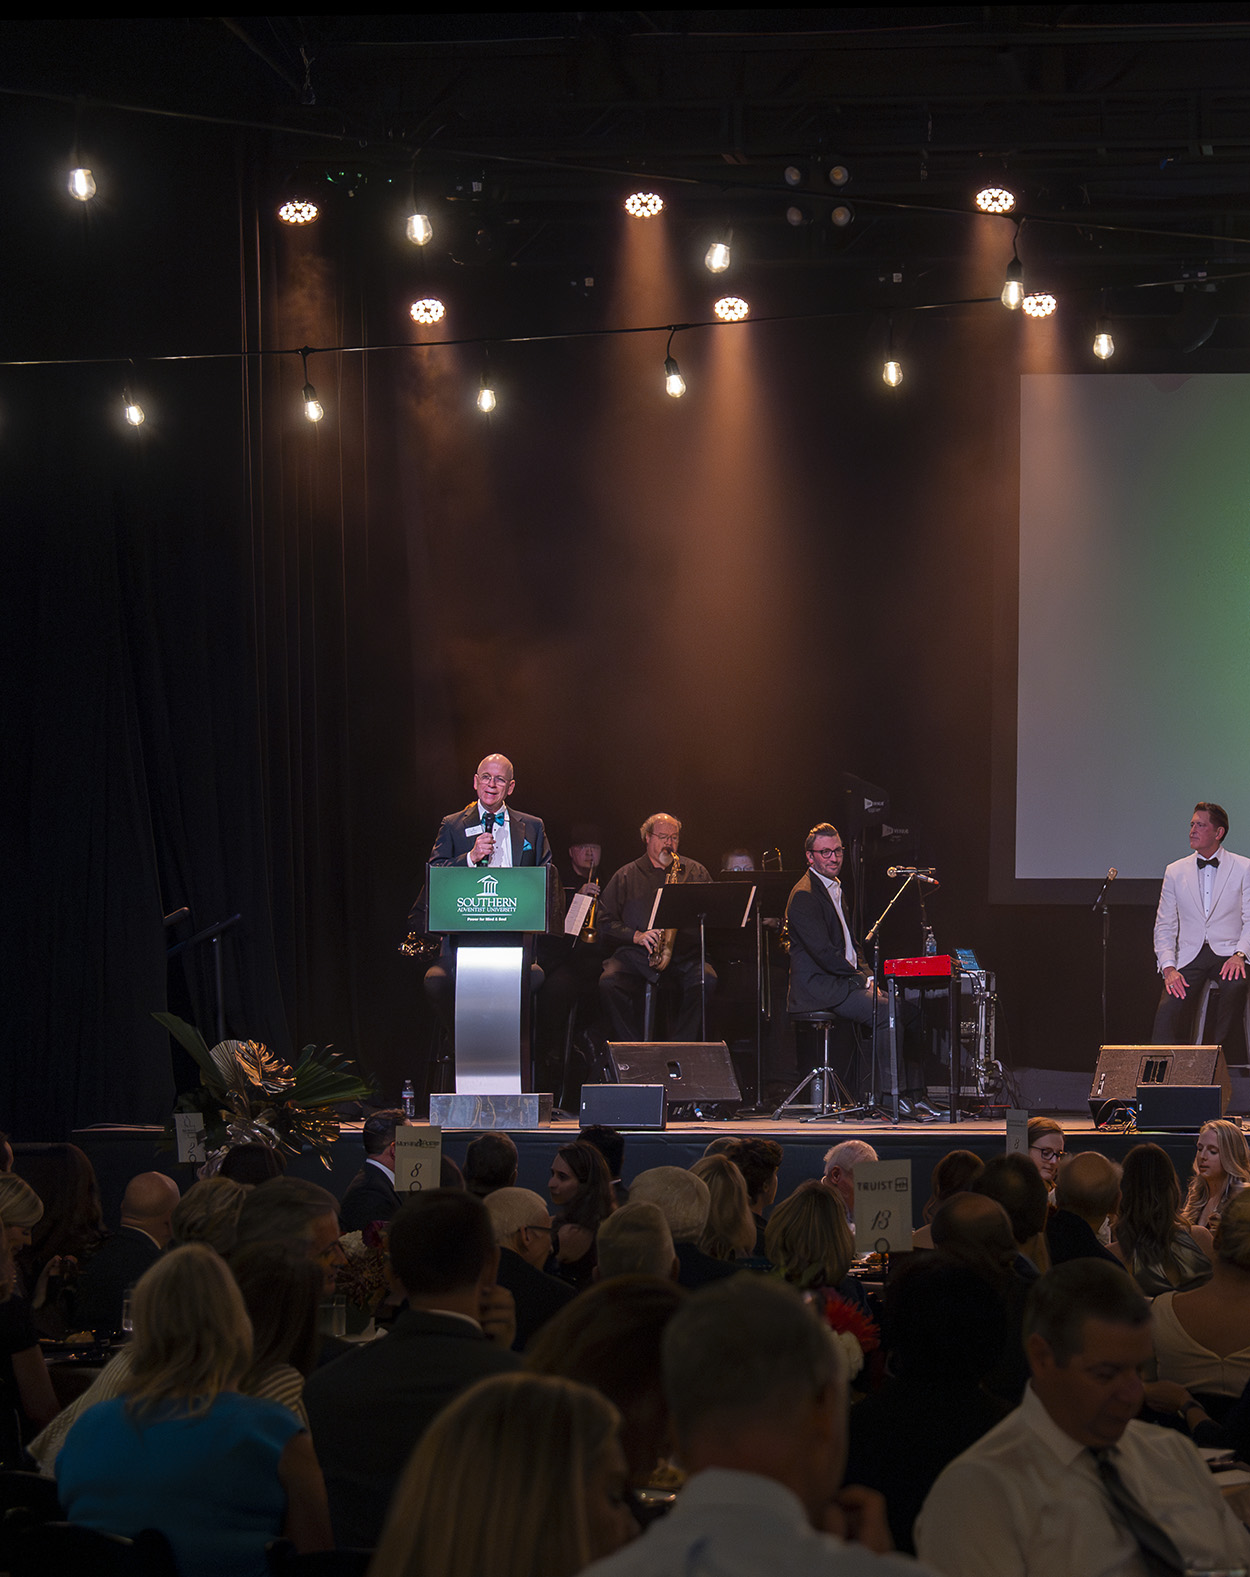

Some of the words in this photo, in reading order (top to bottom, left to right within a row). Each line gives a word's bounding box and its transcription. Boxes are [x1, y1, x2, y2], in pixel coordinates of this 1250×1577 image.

[456, 897, 517, 907] SOUTHERN
[410, 1162, 423, 1178] 8
[857, 1180, 893, 1191] TRUIST
[871, 1210, 892, 1231] 13
